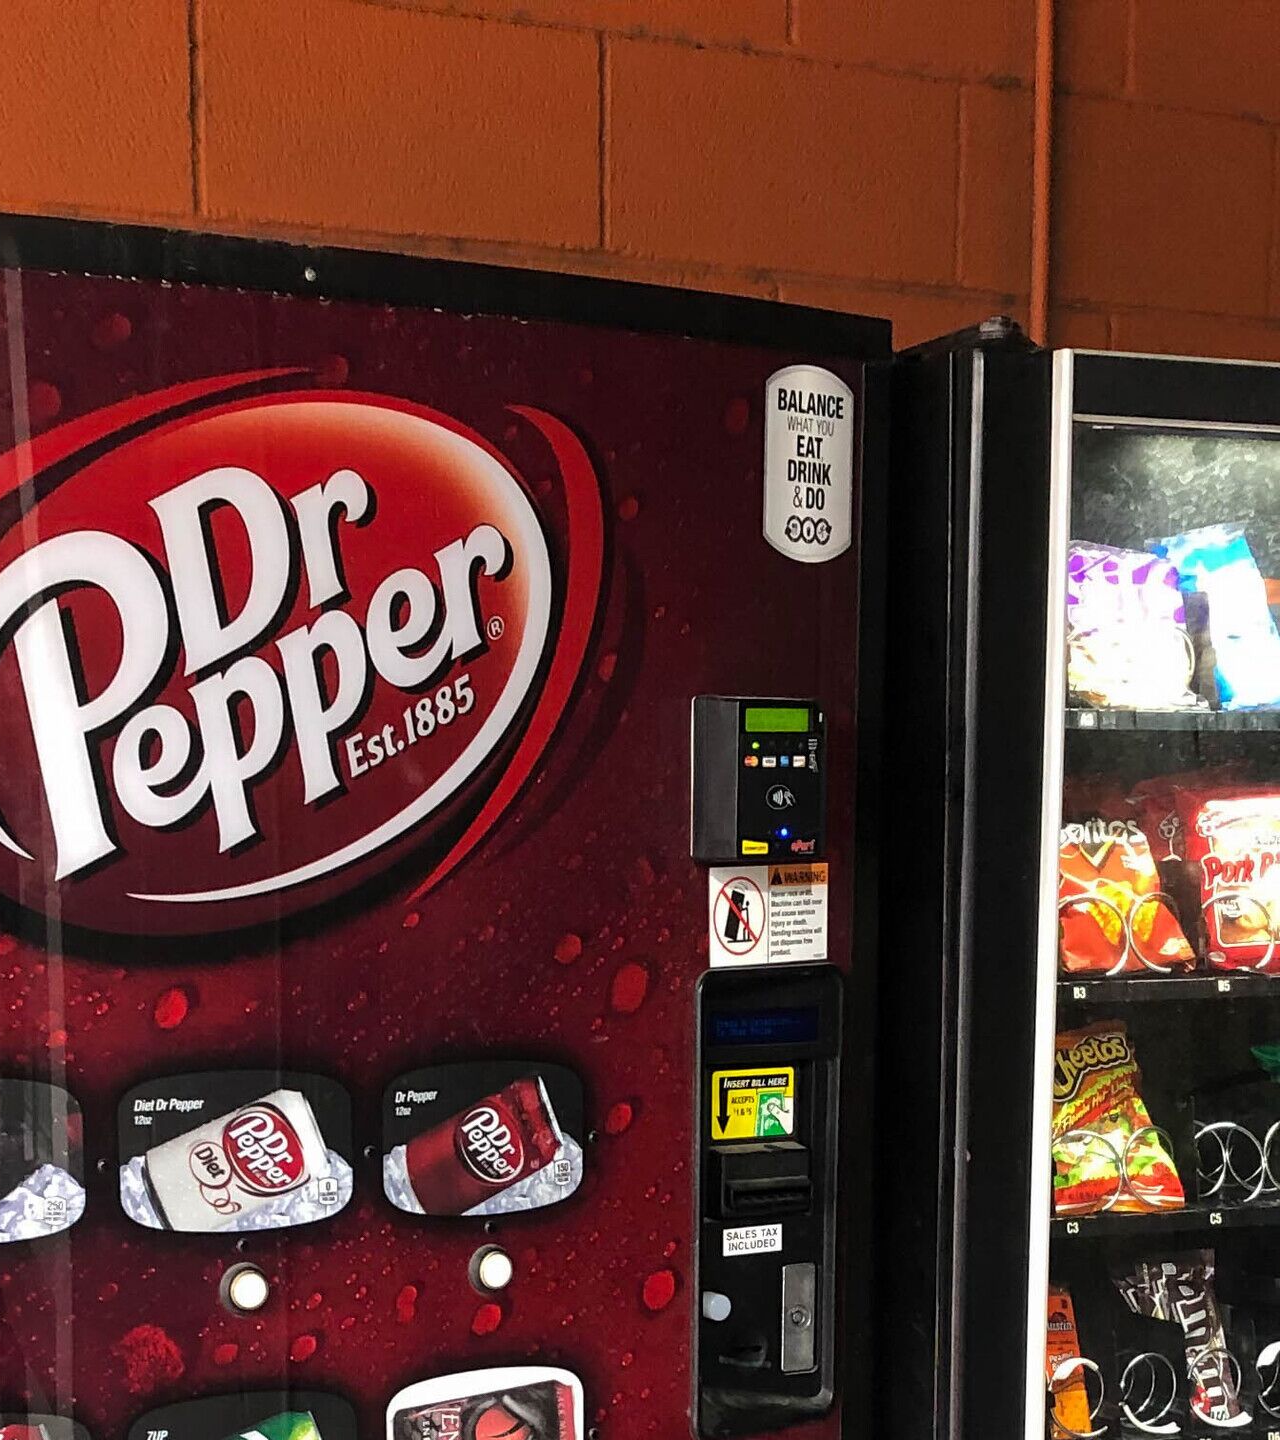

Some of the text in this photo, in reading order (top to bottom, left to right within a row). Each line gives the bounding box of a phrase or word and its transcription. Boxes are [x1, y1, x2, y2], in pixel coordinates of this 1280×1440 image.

[777, 388, 844, 419] BALANCE
[787, 415, 835, 437] WHAT YOU
[787, 459, 832, 486] DRINK
[792, 485, 825, 510] & DO
[150, 466, 370, 676] Dr
[784, 870, 826, 884] WARNING
[1204, 854, 1254, 888] Pork
[1073, 986, 1086, 1000] B3
[1218, 979, 1231, 993] B5
[722, 1076, 788, 1090] INSERT BILL HERE
[395, 1089, 438, 1104] Dr Pepper
[731, 1095, 755, 1105] ACCEPTS
[133, 1098, 205, 1113] Diet Dr Pepper
[395, 1105, 412, 1117] 12oz
[133, 1115, 153, 1126] 12oz
[258, 1130, 293, 1164] Dr
[461, 1107, 515, 1175] Pepper
[488, 1124, 516, 1156] Dr
[229, 1111, 293, 1186] Pepper
[195, 1146, 227, 1179] Diet
[556, 1161, 570, 1173] 150
[325, 1181, 331, 1192] 0
[1209, 1212, 1222, 1225] C5
[726, 1227, 779, 1241] SALES TAX
[1066, 1221, 1079, 1235] C3
[728, 1237, 777, 1251] INCLUDED
